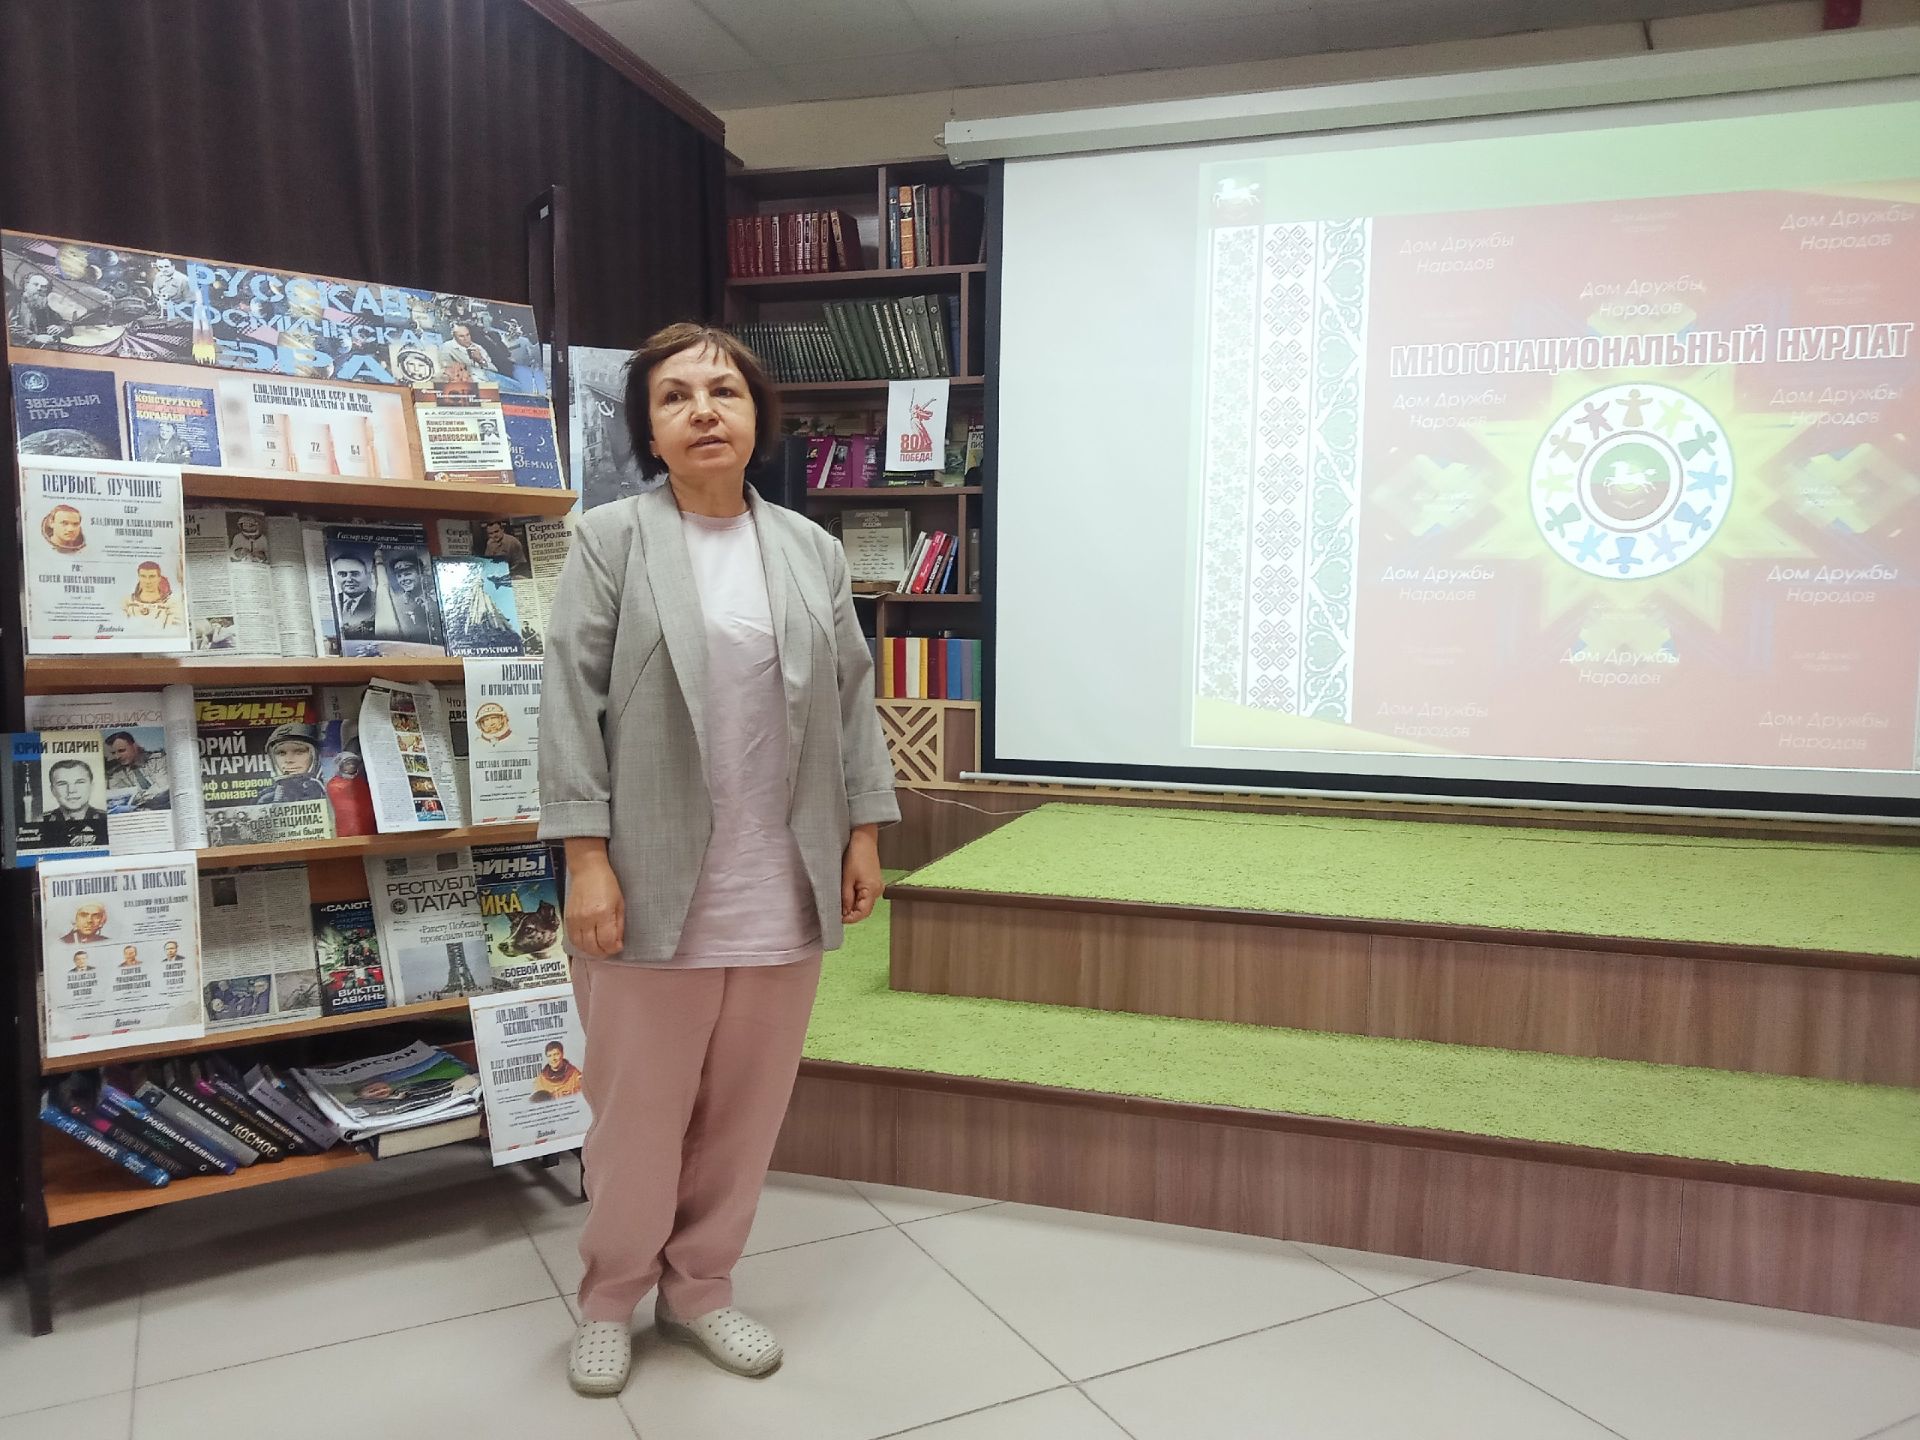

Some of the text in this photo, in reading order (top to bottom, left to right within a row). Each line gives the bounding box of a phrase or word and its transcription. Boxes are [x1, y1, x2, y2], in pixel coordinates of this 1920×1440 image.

[1781, 205, 1917, 231] Дом Дружбы
[1400, 232, 1515, 256] Дом Дружбы
[1801, 233, 1894, 253] Народов
[1416, 257, 1495, 275] Народов
[187, 262, 414, 325] РУССКАЯ
[1579, 281, 1620, 300] Дом
[1600, 302, 1682, 320] Народов
[165, 298, 443, 345] КОСМИЧЕСКАЯ
[1390, 323, 1913, 378] МНОГОНАЦИОНАЛЬНЫЙ НУРЛАТ
[215, 338, 399, 384] ЭРА
[25, 393, 101, 410] ЗВЕЗДНЫЙ
[134, 394, 204, 408] КОНСТРУКТОР
[328, 391, 346, 402] СССР
[1392, 389, 1508, 410] Дом Дружбы
[1769, 383, 1903, 406] Дом Дружбы
[29, 408, 70, 420] ПУТЬ
[1410, 414, 1488, 431] Народов
[1792, 411, 1880, 429] Народов
[428, 433, 479, 443] ЦИОЛКОВСКИЙ
[900, 433, 920, 451] 80
[514, 454, 554, 470] ЗЕМЛИ
[899, 452, 933, 463] ПОБЕДА!
[107, 478, 163, 498] ЛУЧШИЕ
[528, 521, 565, 533] Сергей
[1381, 564, 1495, 583] Дом Дружбы
[1766, 563, 1898, 584] Дом Дружбы
[1399, 587, 1477, 604] Народов
[1786, 587, 1877, 606] Народов
[451, 646, 519, 657] КОНСТРУКТОРЫ
[1560, 647, 1680, 666] Дом Дружбы
[1578, 669, 1661, 687] Народов
[195, 700, 306, 722] Тайны
[1376, 701, 1488, 720] Дом Дружбы
[1759, 711, 1889, 729] Дом Дружбы
[1393, 722, 1470, 738] Народов
[14, 740, 101, 756] ЮРИЙ ГАГАРИН
[1778, 733, 1868, 750] Народов
[232, 778, 273, 790] первом
[270, 803, 322, 817] КАРЛИКИ
[250, 815, 323, 833] ОСВЕНЦИМА:
[52, 870, 187, 898] ПОГИБШИЕ ЗА КОСМОС
[495, 1000, 568, 1024] ДАЛЬШЕ ТОЛЬКО
[504, 1017, 564, 1036] БЕСКОНЕЧНОСТЬ
[142, 1113, 187, 1145] УРОДЛИВАЯ
[184, 1139, 227, 1170] ВСЕЛЕННАЯ
[230, 1123, 279, 1159] КОСМОС
